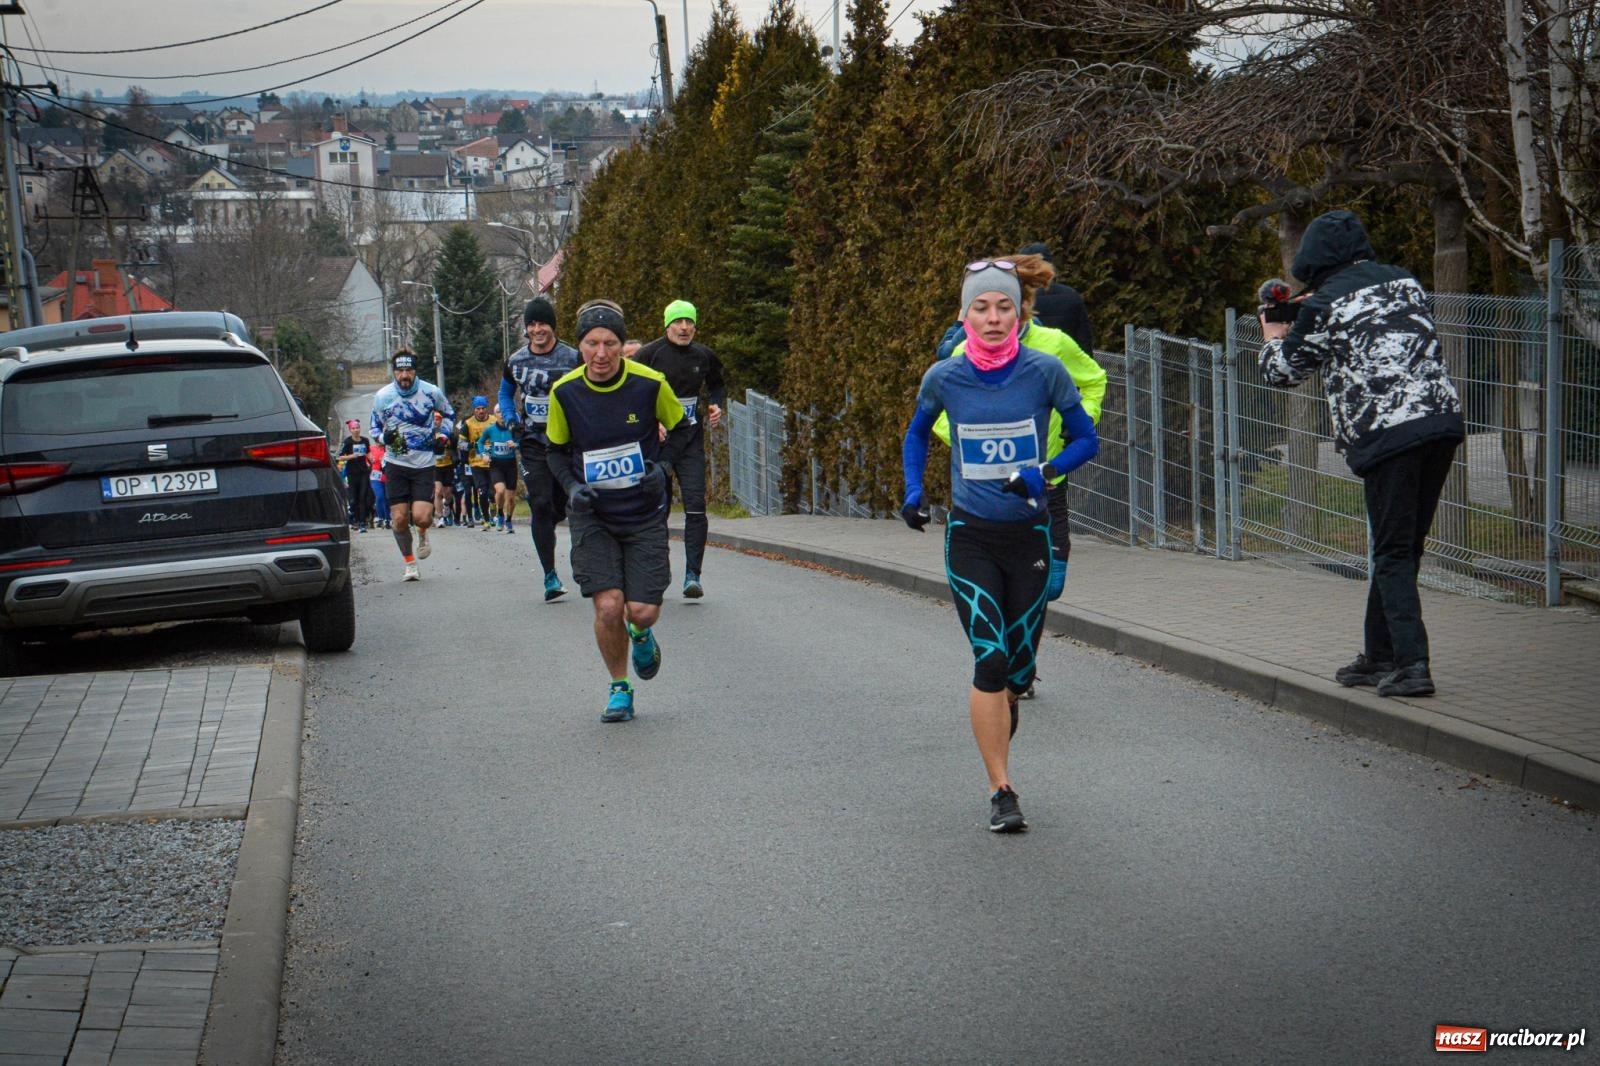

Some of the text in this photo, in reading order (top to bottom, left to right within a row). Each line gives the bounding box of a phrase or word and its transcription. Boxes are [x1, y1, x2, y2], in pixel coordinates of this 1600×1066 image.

[981, 439, 1016, 463] 90
[595, 456, 634, 480] 200
[151, 471, 211, 493] 1239P
[138, 512, 192, 523] Ateca
